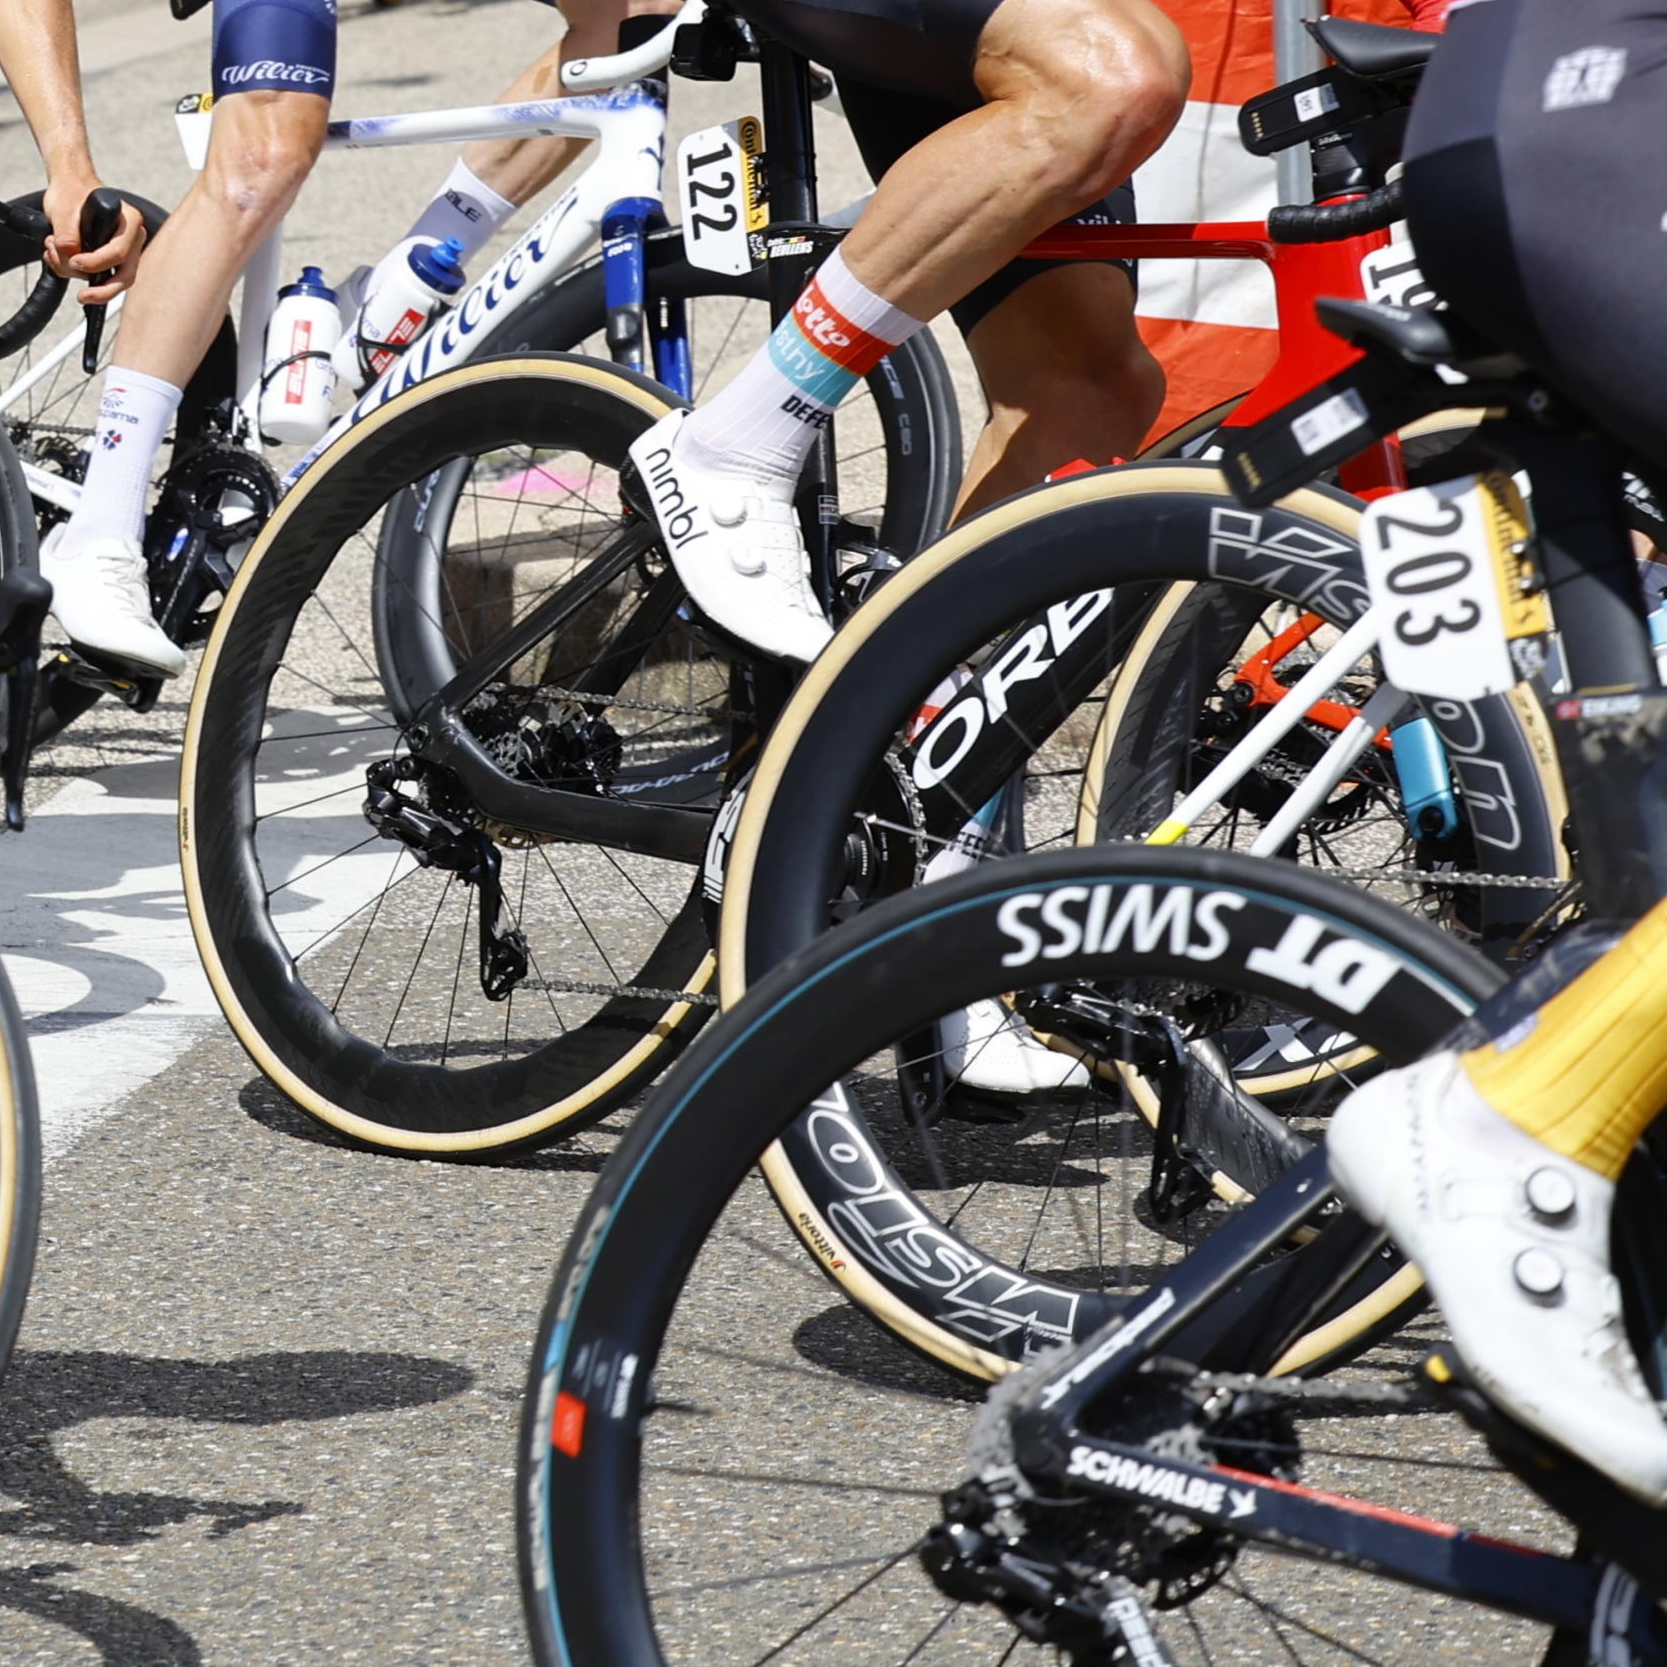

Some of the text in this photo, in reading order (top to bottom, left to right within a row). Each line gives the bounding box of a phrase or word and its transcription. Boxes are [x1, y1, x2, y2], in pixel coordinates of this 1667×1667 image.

[221, 59, 331, 85] Wilier
[686, 142, 738, 242] 122
[1369, 256, 1449, 313] 19
[775, 325, 826, 382] stny
[780, 393, 831, 431] DEFE
[645, 445, 710, 551] nimbl
[1375, 499, 1482, 647] 203
[911, 587, 1116, 791] ORB
[996, 880, 1402, 1018] SWISS DT
[1066, 1444, 1229, 1515] SCHWALBE
